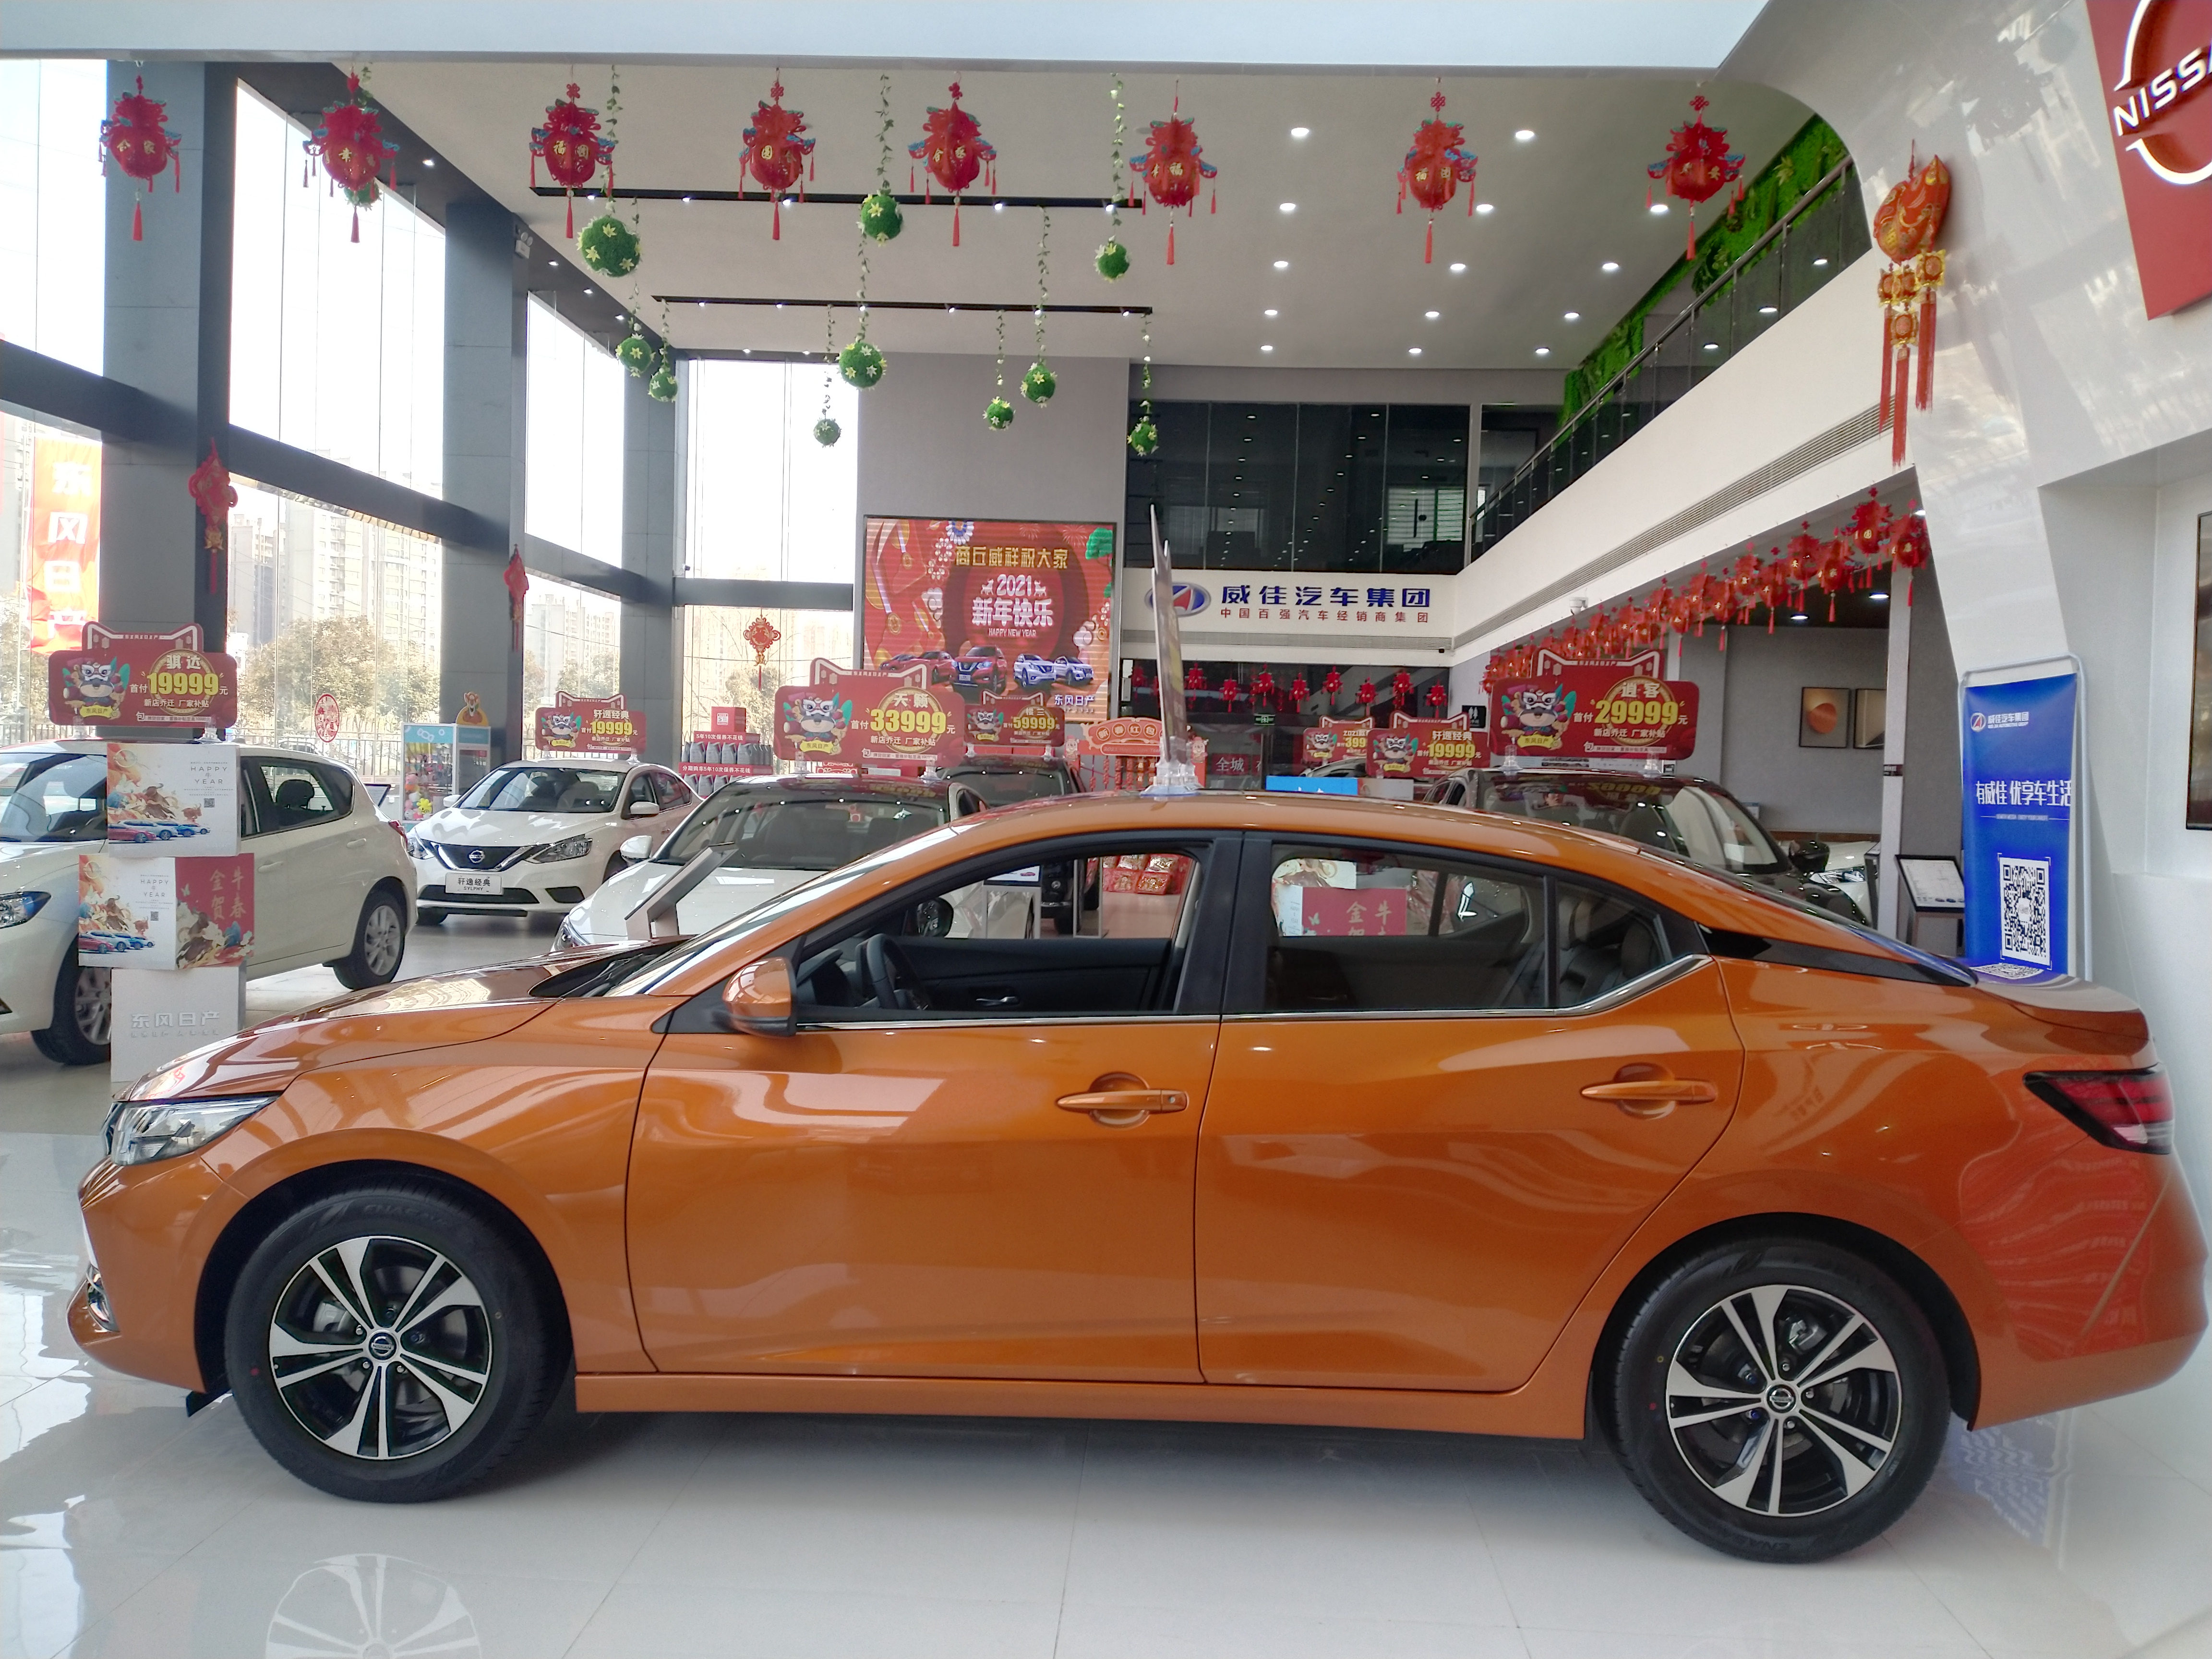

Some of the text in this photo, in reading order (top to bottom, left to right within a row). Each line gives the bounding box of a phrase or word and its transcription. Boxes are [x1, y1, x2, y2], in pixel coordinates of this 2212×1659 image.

[2113, 39, 2212, 136] NISS
[1169, 162, 1184, 176] 福
[956, 545, 1068, 569] 商丘威祥祝大家
[997, 574, 1032, 596] 2021
[1222, 585, 1431, 608] 威佳汽车集团
[971, 597, 1053, 627] 新年快乐
[1221, 608, 1429, 623] 中国百强汽车经销商集团
[989, 627, 1007, 636] HAPPY
[166, 655, 202, 670] 骐达
[1620, 682, 1660, 698] 逍客
[144, 698, 209, 708] 新店乔迁 厂家补贴
[894, 693, 929, 708] 天籁
[1054, 694, 1094, 706] 东风日产
[593, 709, 629, 720] 轩逸经典
[1025, 708, 1045, 716] 楼兰
[1988, 711, 2029, 724] 威佳汽车集团
[1432, 730, 1472, 741] 轩逸经典
[1593, 728, 1666, 738] 新店乔迁 厂家补贴
[870, 735, 936, 746] 新店乔迁 厂家补贴
[682, 765, 751, 774] 分期购车5年10次保养不花钱
[1216, 757, 1245, 772] 全城
[1975, 780, 2071, 806] 有威佳 优享车生活
[457, 877, 491, 887] 轩逸经典
[132, 1011, 220, 1028] 东风日产
